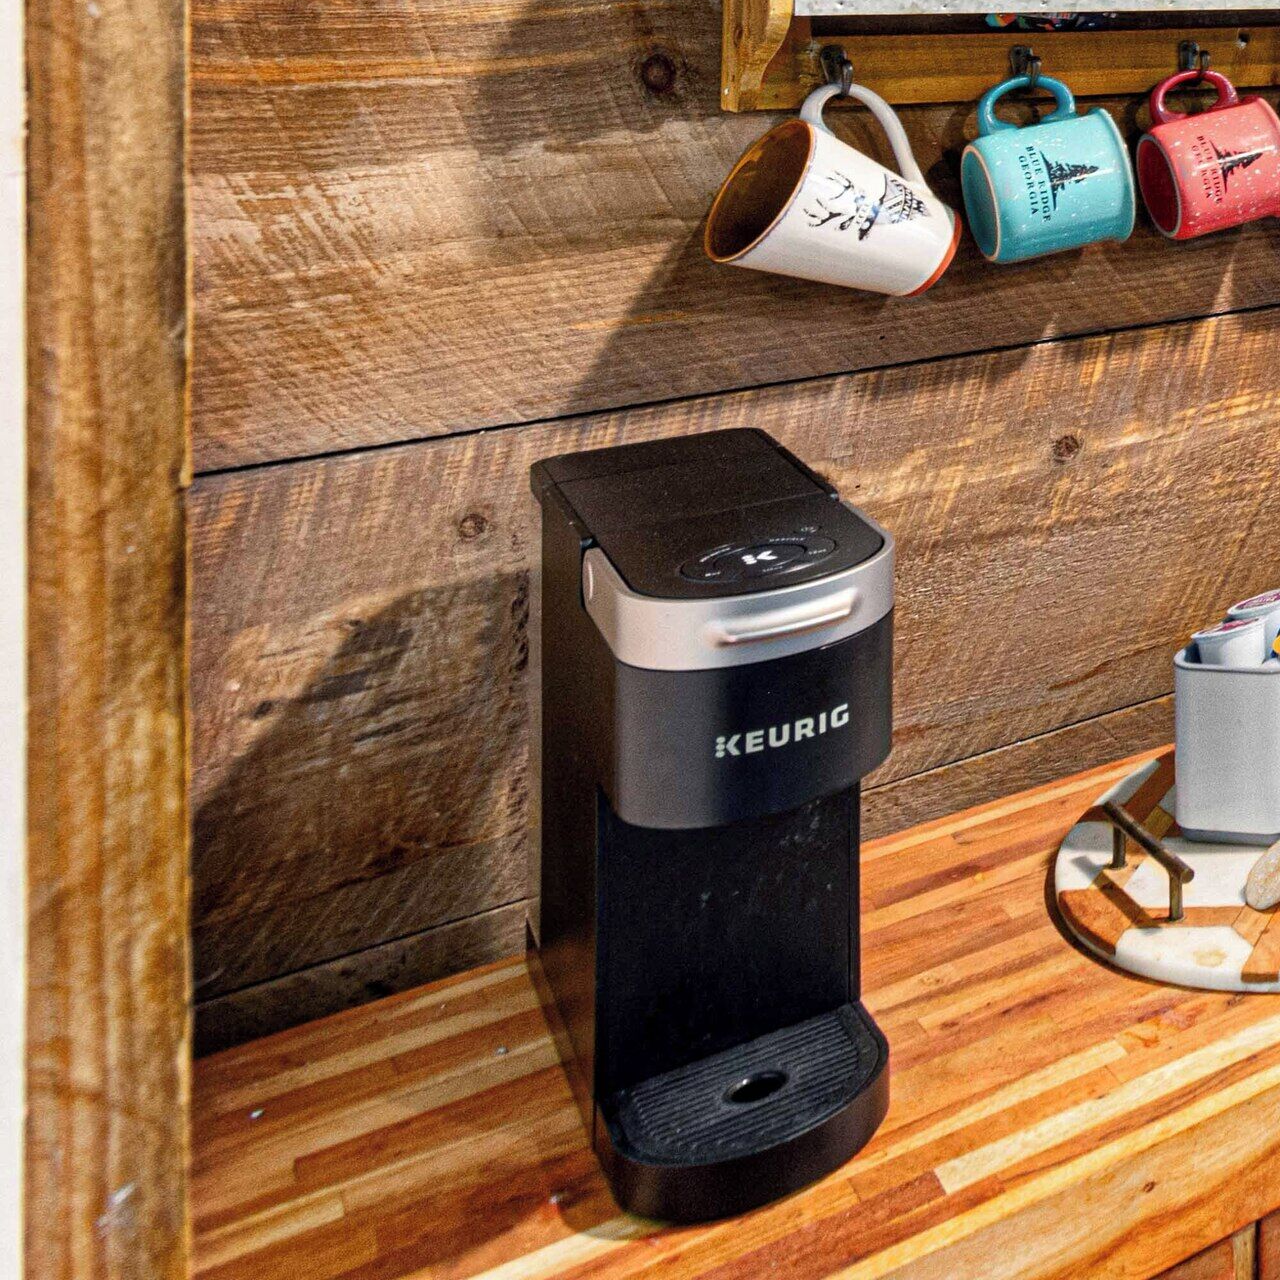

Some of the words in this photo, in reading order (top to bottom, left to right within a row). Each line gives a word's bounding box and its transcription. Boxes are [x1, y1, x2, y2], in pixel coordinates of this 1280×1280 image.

[1018, 155, 1039, 214] GEORGIA
[1025, 145, 1042, 175] BLUE
[1038, 180, 1051, 222] RIDGE
[714, 703, 850, 759] KEURIG
